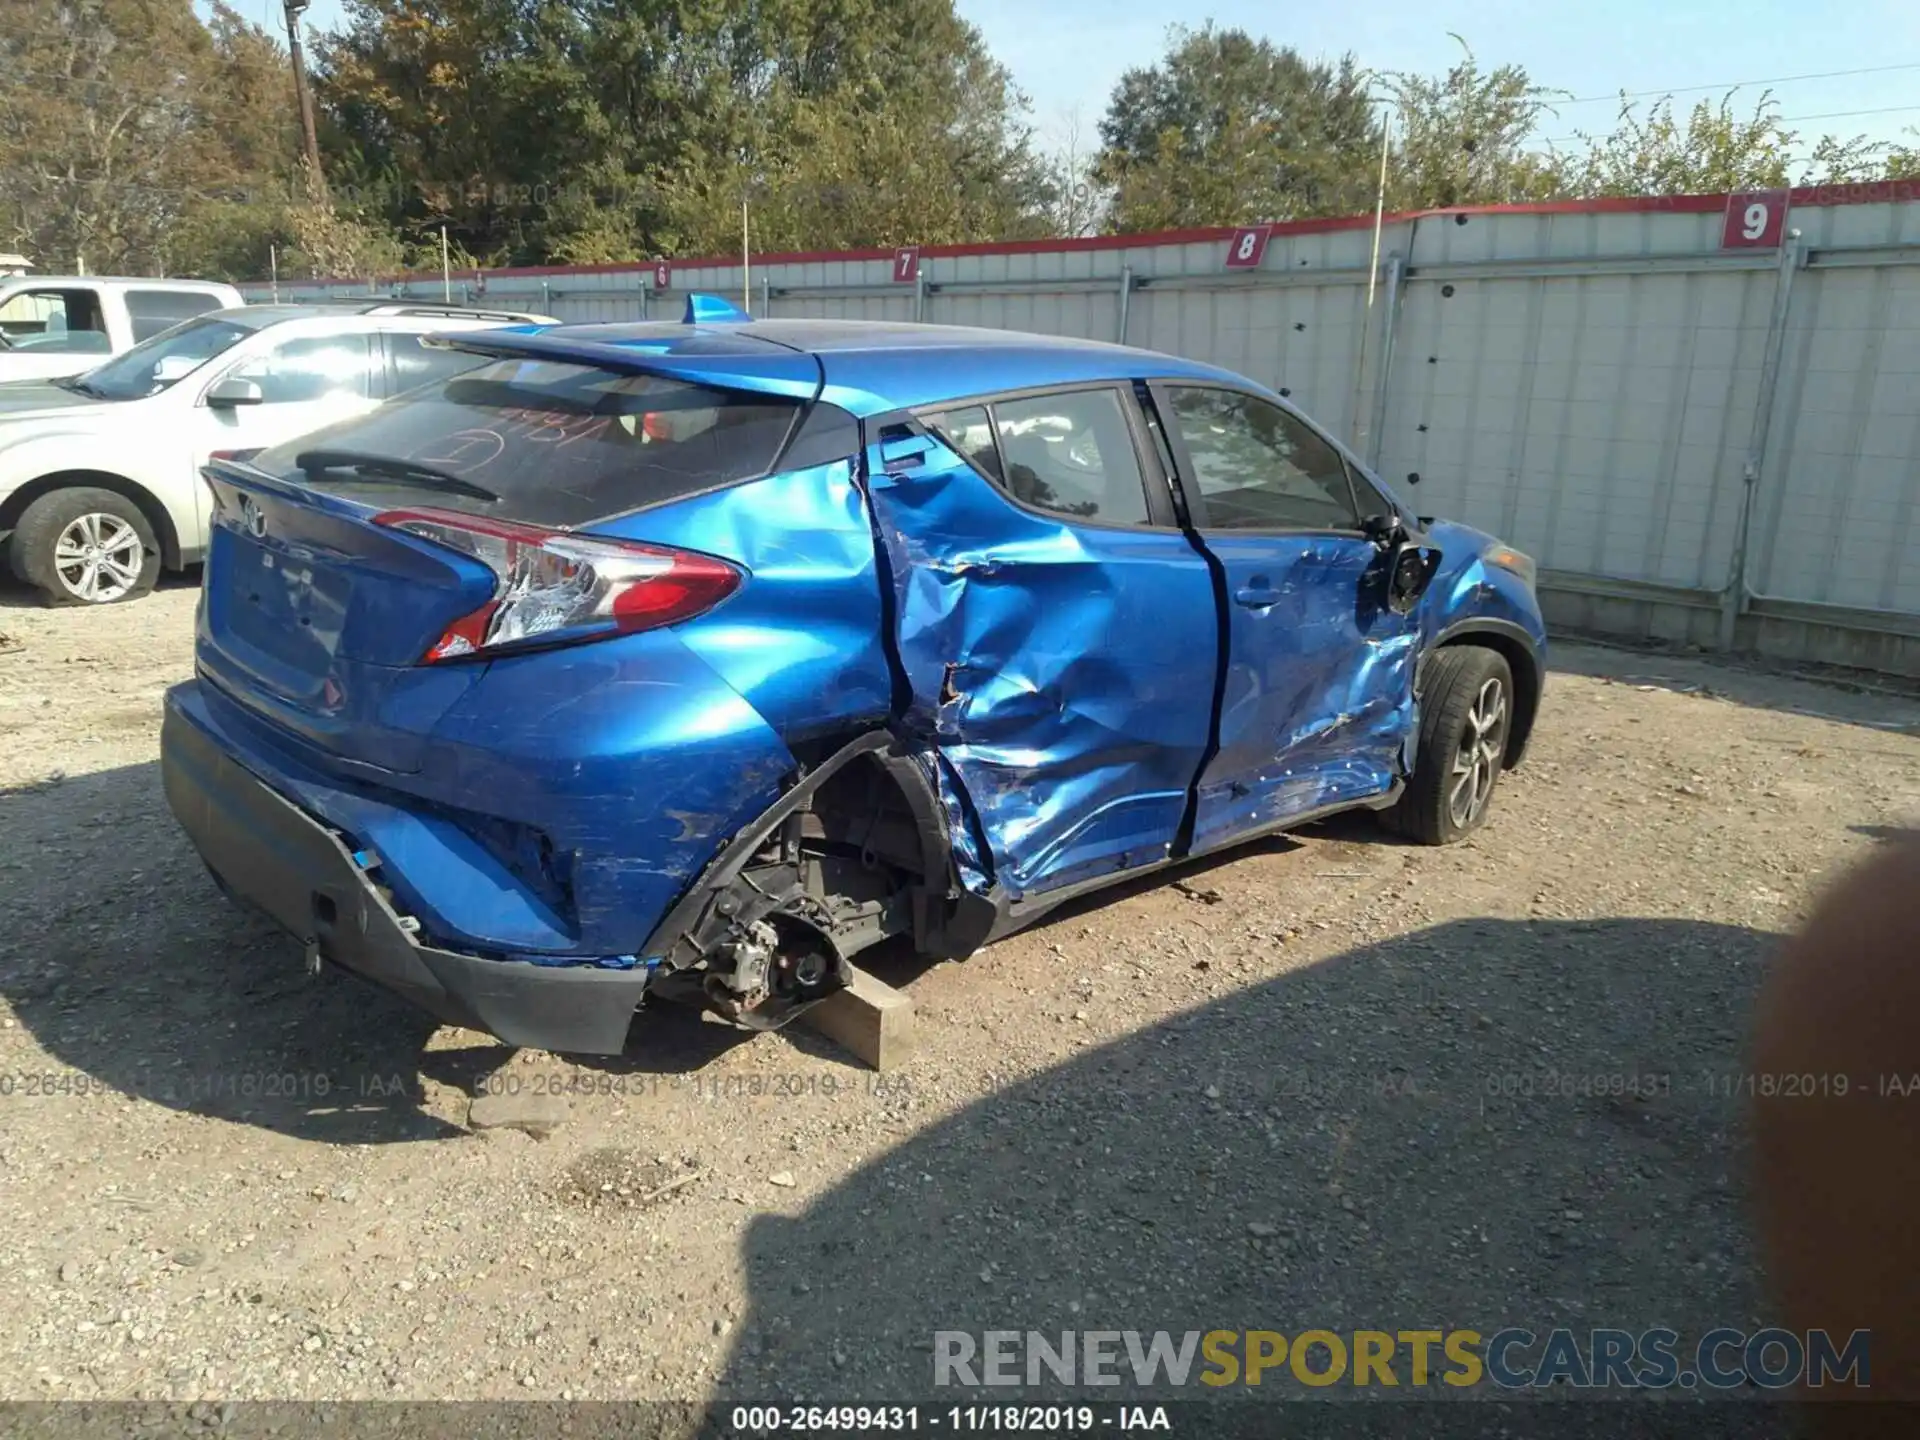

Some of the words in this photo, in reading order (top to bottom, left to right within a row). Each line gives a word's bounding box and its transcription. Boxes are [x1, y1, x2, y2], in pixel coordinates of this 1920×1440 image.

[1743, 203, 1768, 240] 9
[1238, 233, 1256, 260] 8
[901, 252, 911, 277] 7
